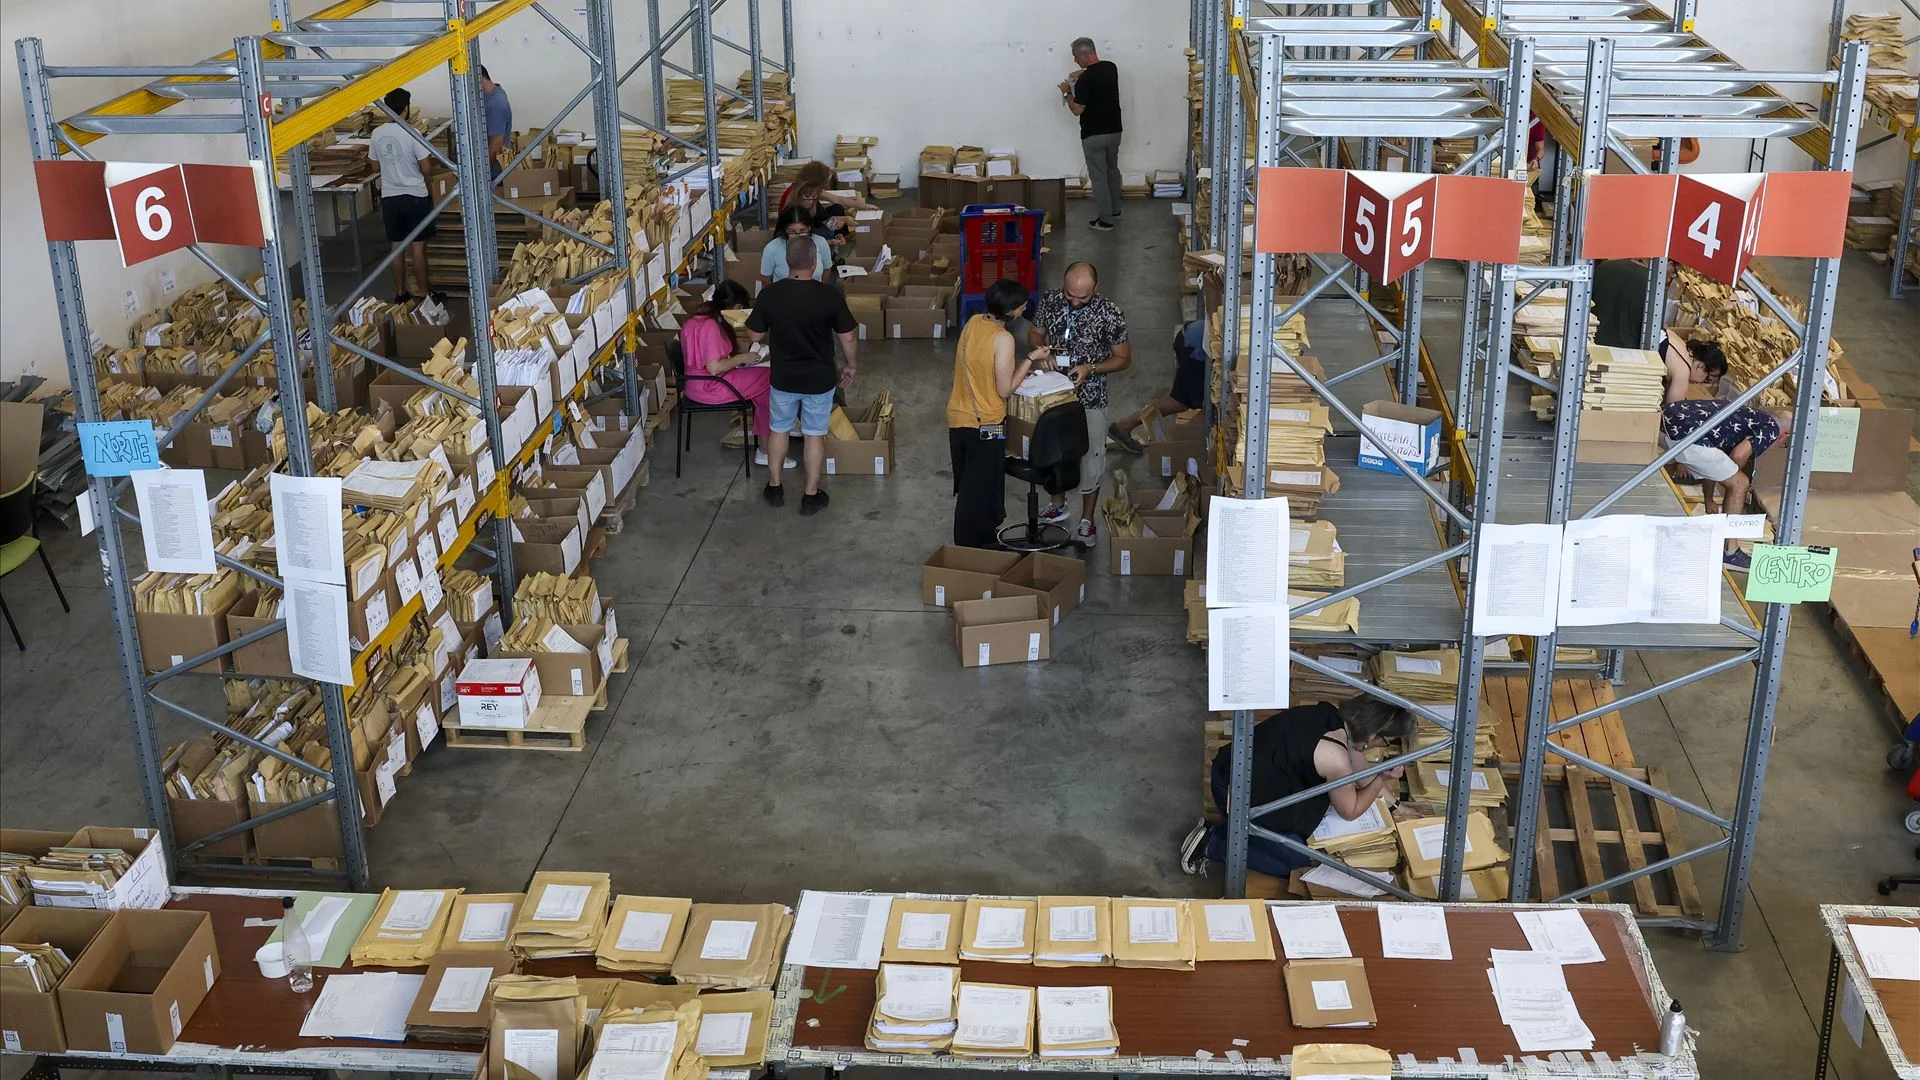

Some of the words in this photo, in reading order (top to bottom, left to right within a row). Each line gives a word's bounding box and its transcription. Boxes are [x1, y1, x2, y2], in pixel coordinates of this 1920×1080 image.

[263, 97, 270, 112] C
[135, 186, 173, 241] 6
[1354, 195, 1376, 255] 5
[1400, 196, 1423, 257] 5
[1687, 201, 1721, 259] 4
[1743, 197, 1759, 254] 4
[93, 430, 152, 463] NORTE
[1728, 520, 1760, 528] CENTRO
[1755, 553, 1831, 588] CENTRO
